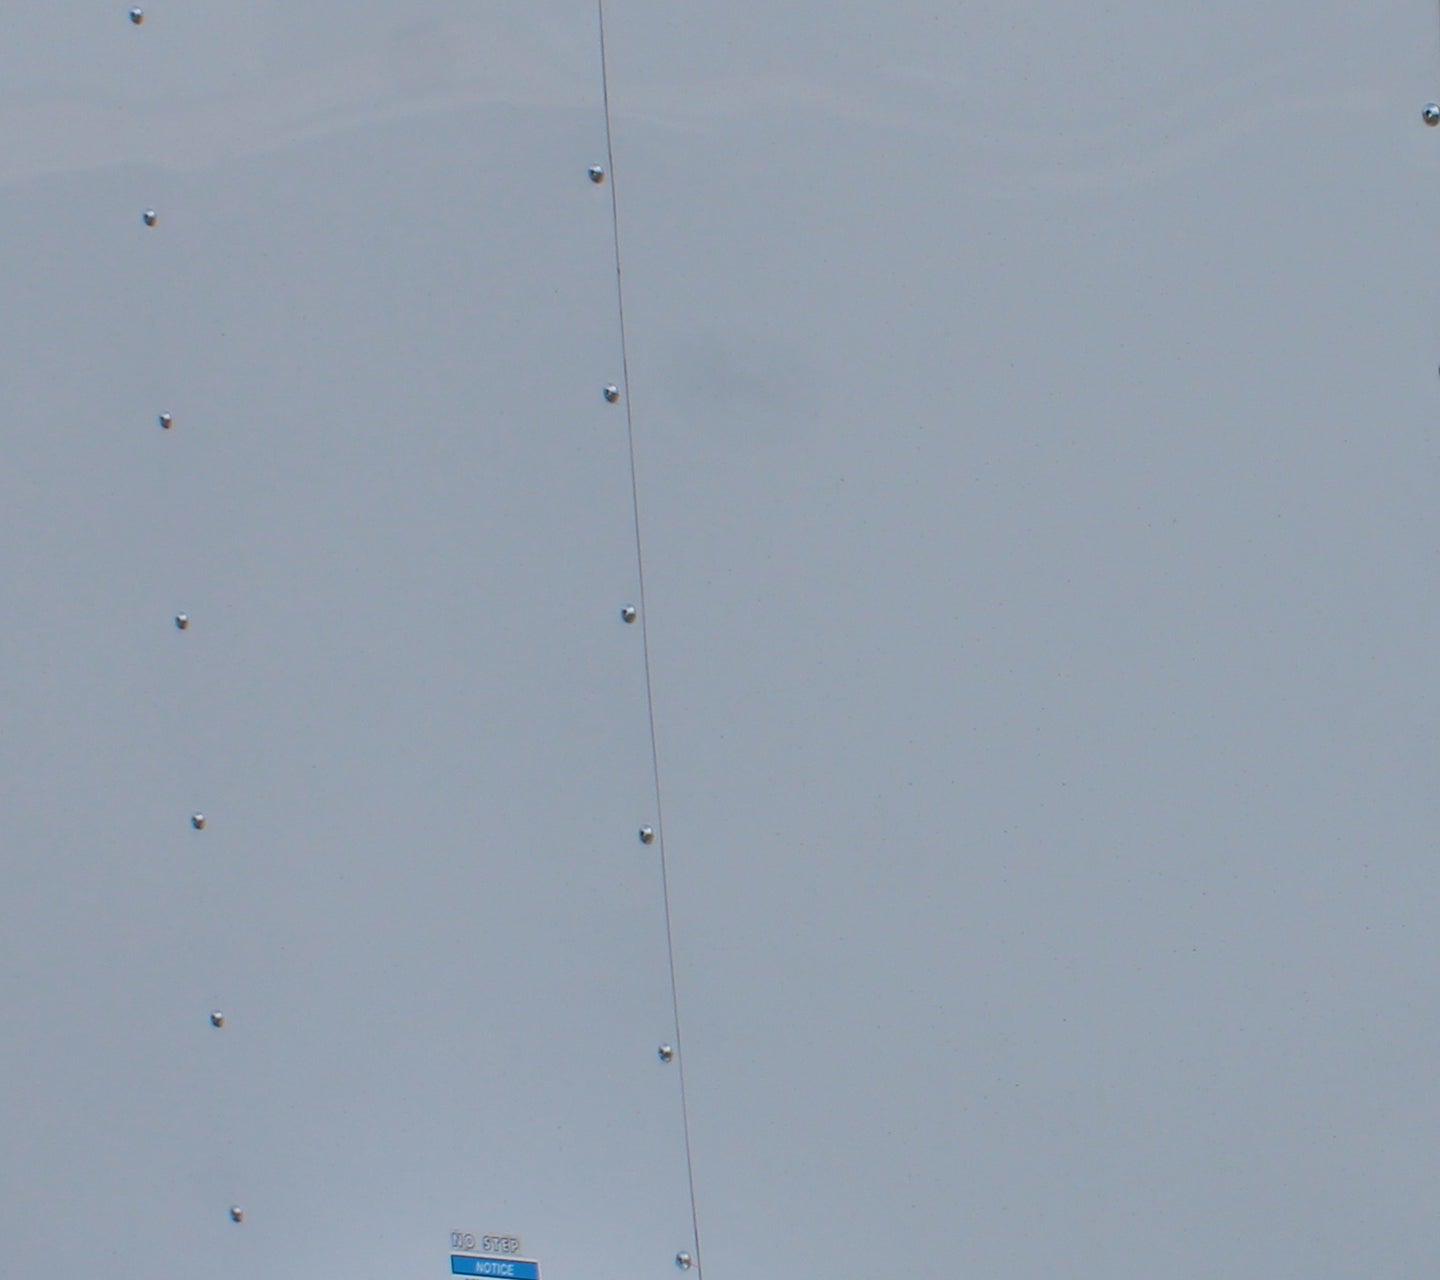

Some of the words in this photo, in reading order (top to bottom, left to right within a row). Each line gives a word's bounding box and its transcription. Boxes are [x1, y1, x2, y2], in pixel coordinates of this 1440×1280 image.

[451, 1232, 475, 1250] NO
[482, 1235, 520, 1253] STEP
[476, 1261, 515, 1276] NOTICE
